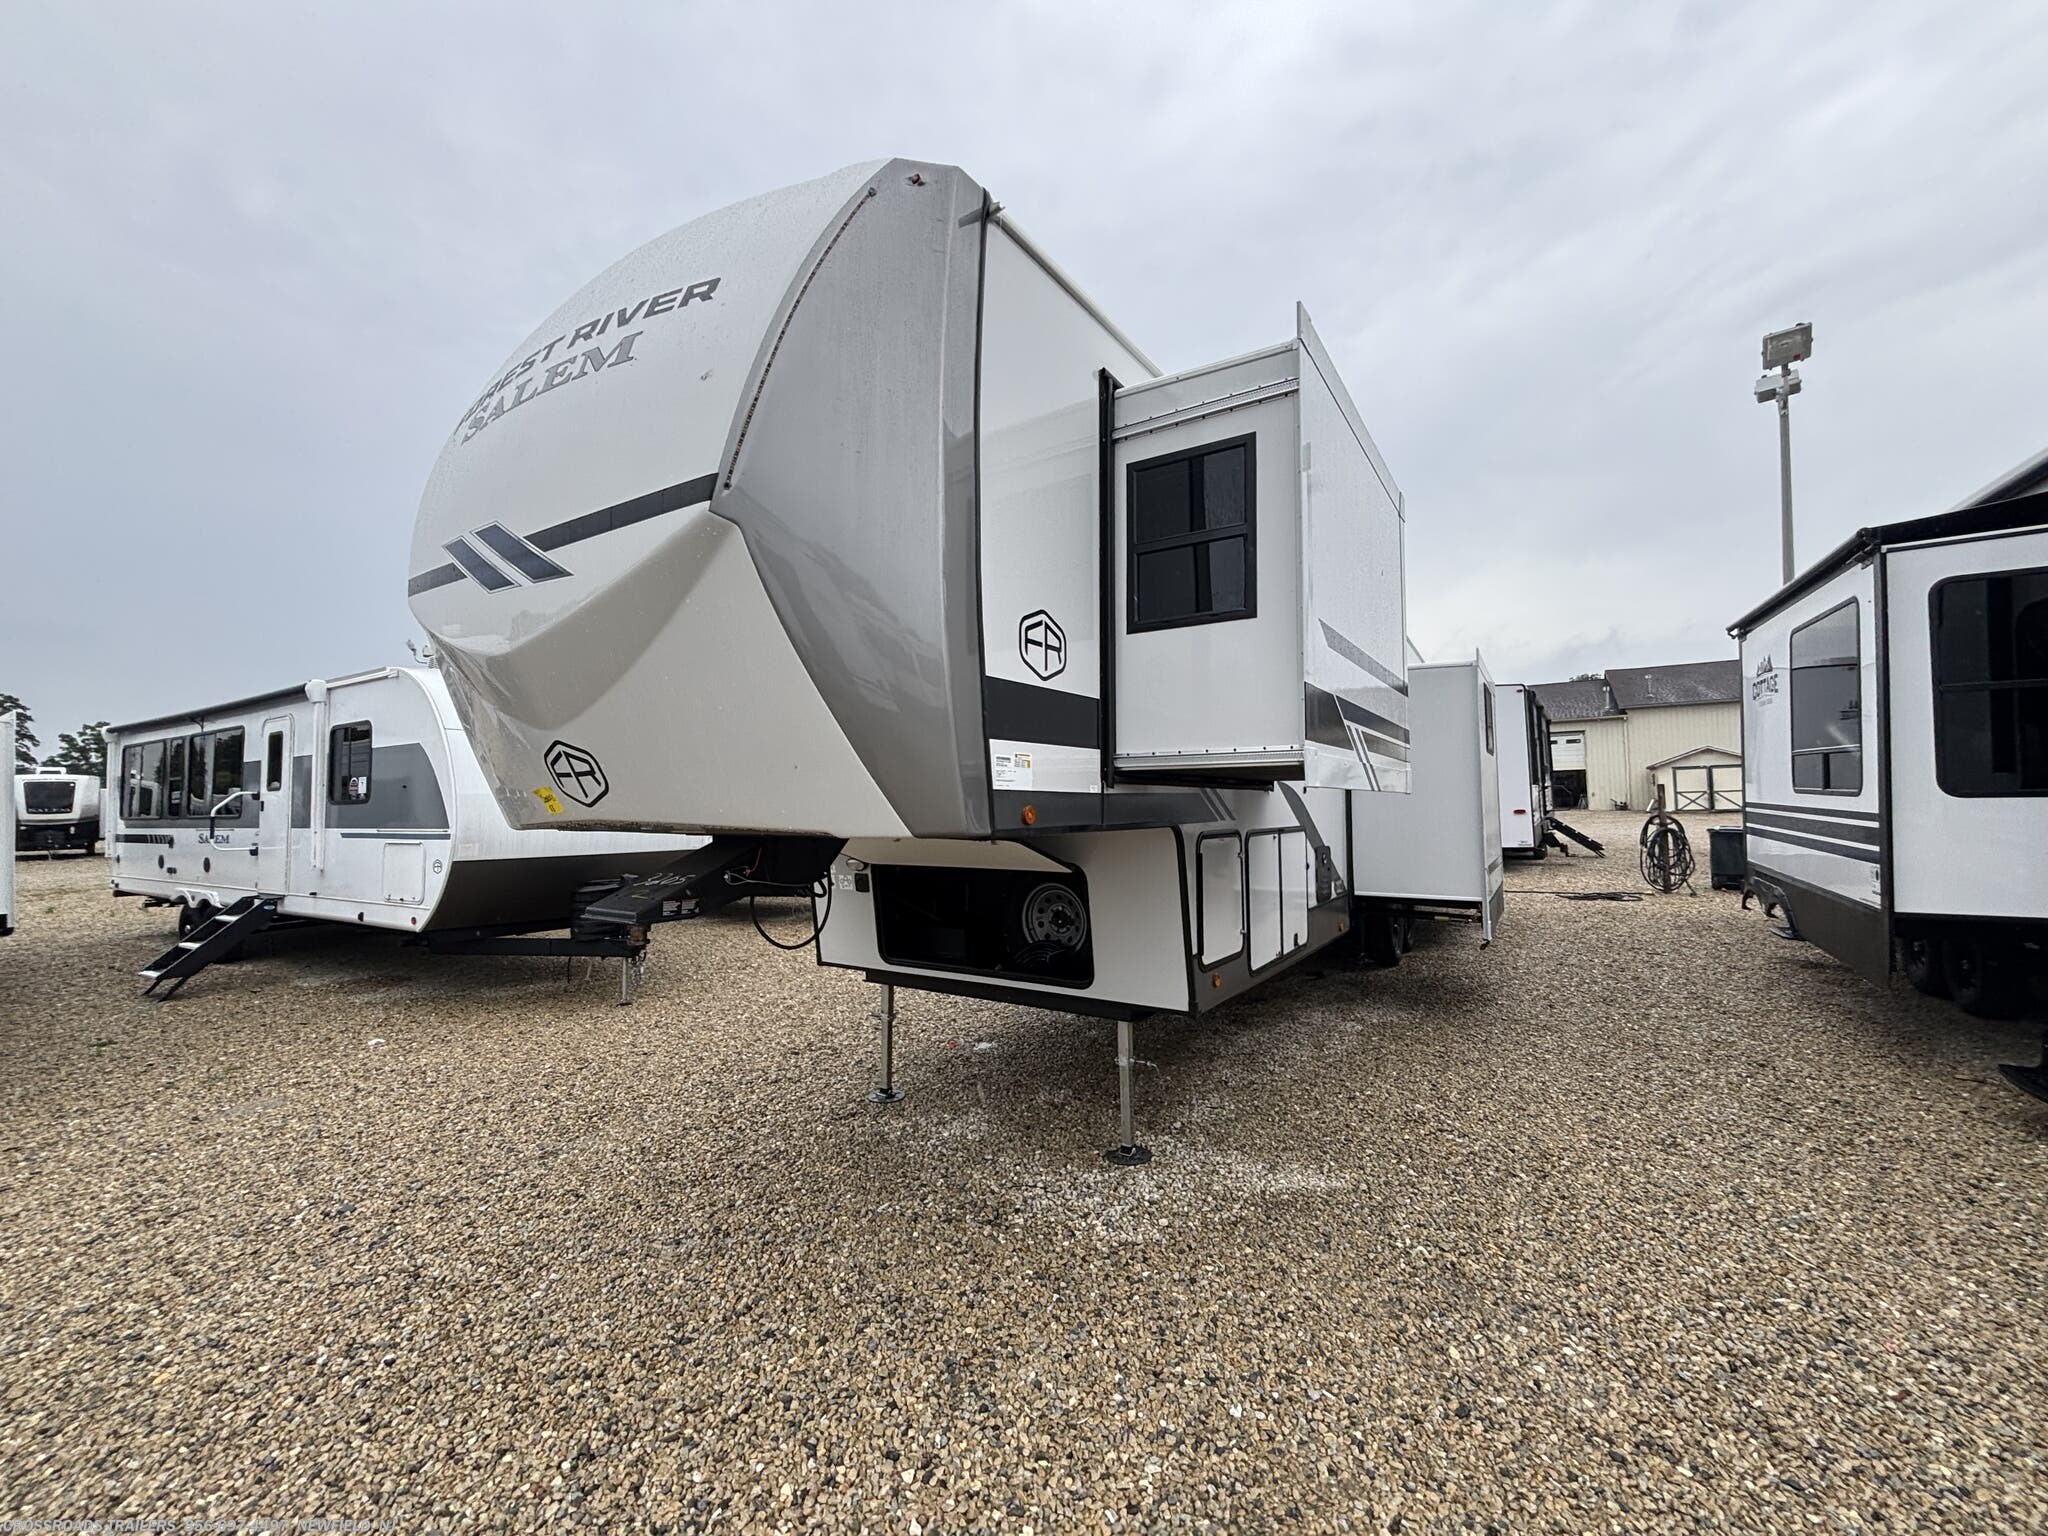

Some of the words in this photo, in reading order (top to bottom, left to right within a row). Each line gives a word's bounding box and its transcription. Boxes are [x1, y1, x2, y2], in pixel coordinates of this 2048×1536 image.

[567, 277, 721, 349] RIVER
[461, 331, 643, 446] SALEM
[198, 833, 230, 844] SAEM
